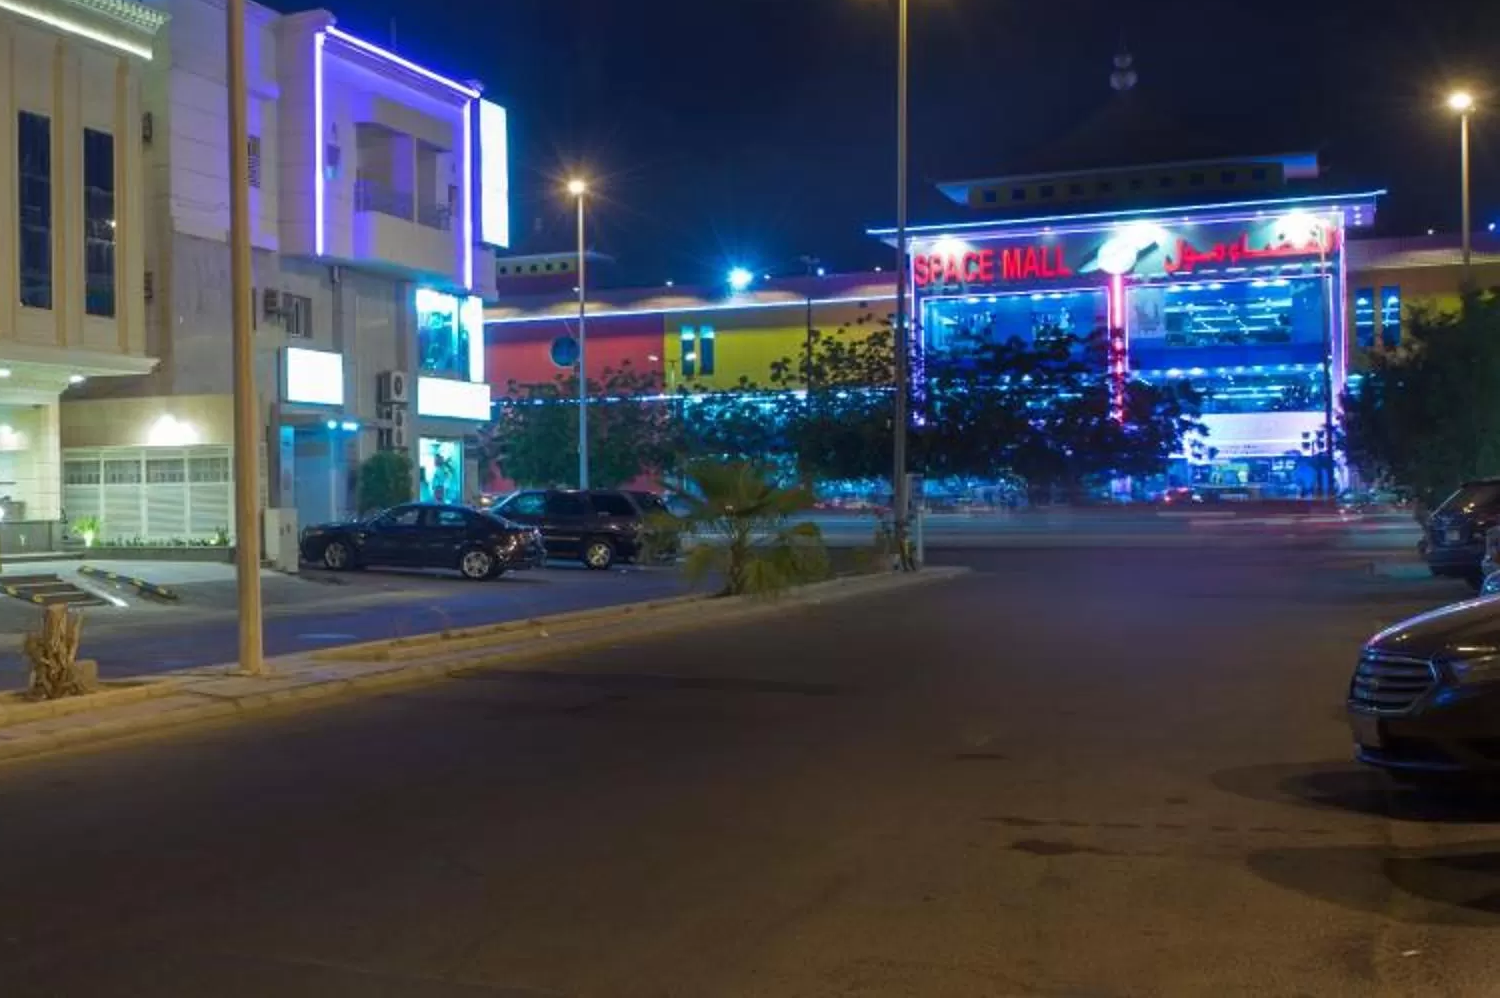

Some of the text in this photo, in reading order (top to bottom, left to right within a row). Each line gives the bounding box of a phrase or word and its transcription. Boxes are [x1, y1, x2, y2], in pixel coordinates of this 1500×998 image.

[913, 245, 1072, 286] SPACE MALL
[1163, 237, 1226, 273] مول
